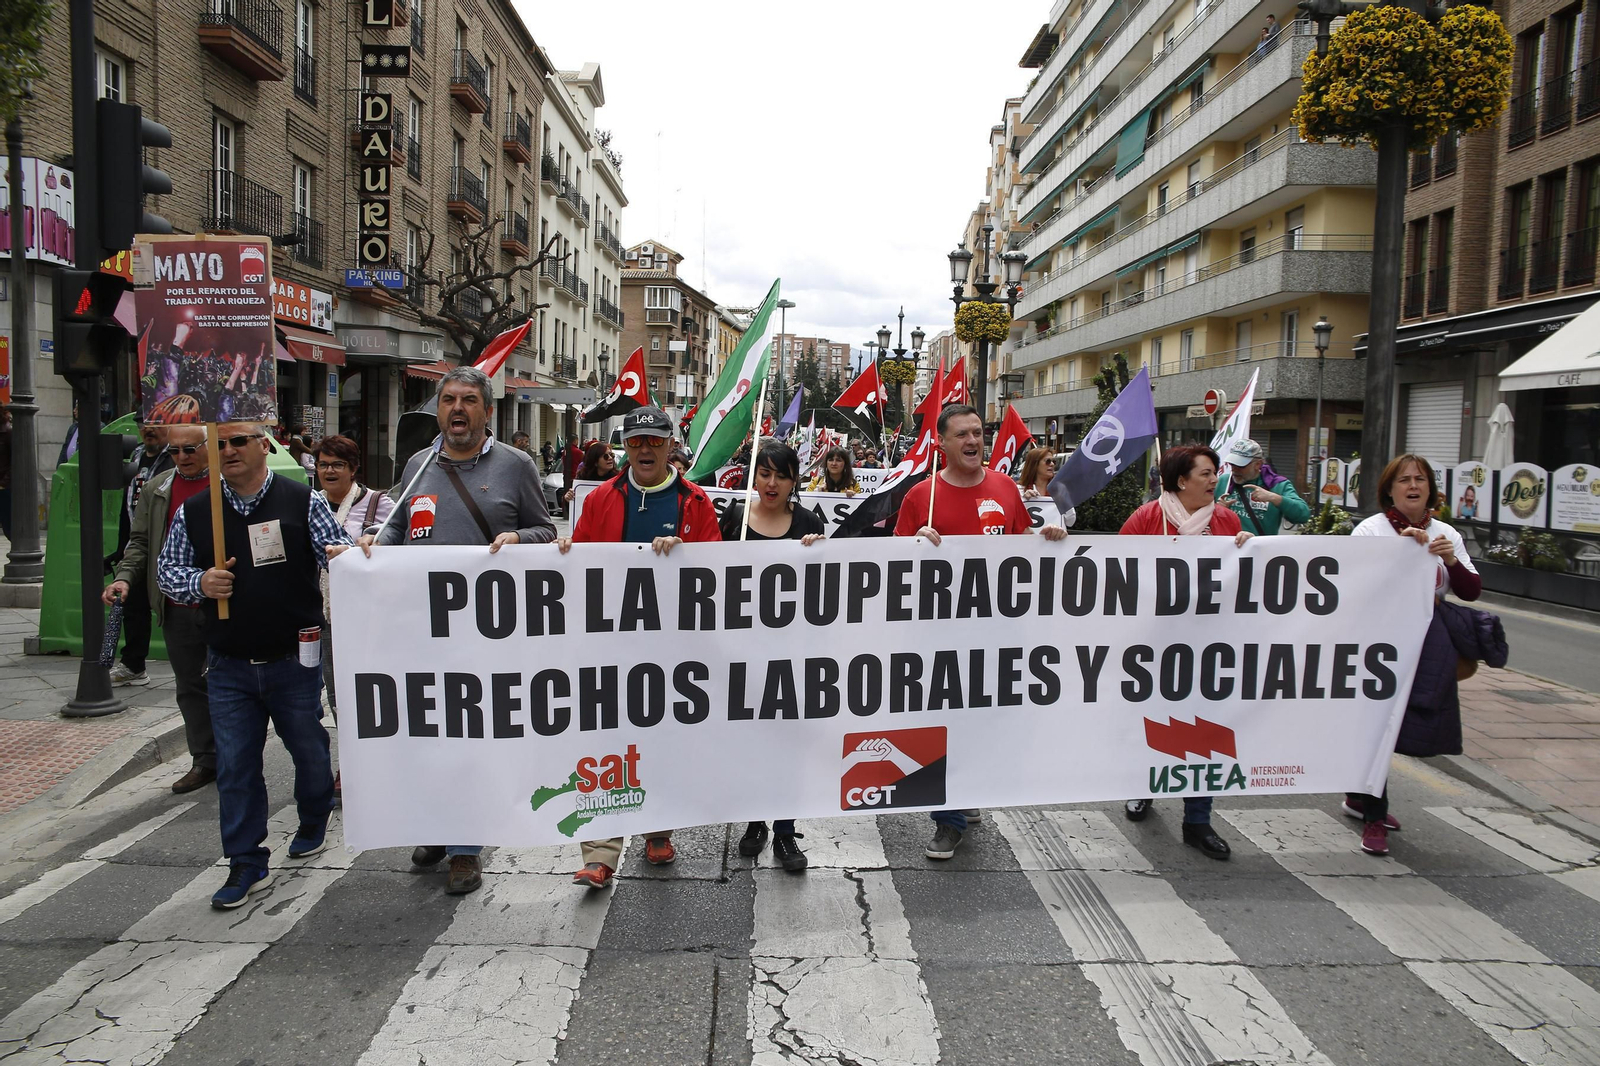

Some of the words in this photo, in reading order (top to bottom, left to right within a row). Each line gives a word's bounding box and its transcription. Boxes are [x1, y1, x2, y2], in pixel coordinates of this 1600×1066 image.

[363, 96, 389, 262] DAURO
[154, 252, 224, 282] MAYO
[243, 274, 264, 283] CGT
[348, 270, 401, 281] PARKING
[167, 288, 184, 296] POR
[198, 287, 238, 295] REPARTO
[240, 287, 256, 295] DEL
[227, 297, 266, 305] RIQUEZA
[342, 335, 381, 348] HOTEL
[636, 414, 655, 424] Lee
[1501, 478, 1546, 508] Desi
[411, 526, 432, 539] CGT
[982, 525, 1005, 535] CGT
[427, 568, 566, 640] POR
[585, 567, 661, 633] LA
[678, 545, 1139, 631] RECUPERACIÓN
[1155, 557, 1222, 616] DE
[1234, 556, 1340, 616] LOS
[355, 660, 711, 739] DERECHOS
[727, 644, 1061, 721] LABORALES
[1075, 645, 1110, 704] Y
[1120, 642, 1399, 703] SOCIALES
[576, 744, 641, 794] sat
[1250, 765, 1306, 776] INTERSINDICAL
[1149, 763, 1247, 794] USTEA
[1250, 777, 1289, 788] ANDALUZA
[575, 790, 643, 812] Sindicato
[846, 784, 896, 807] CGT
